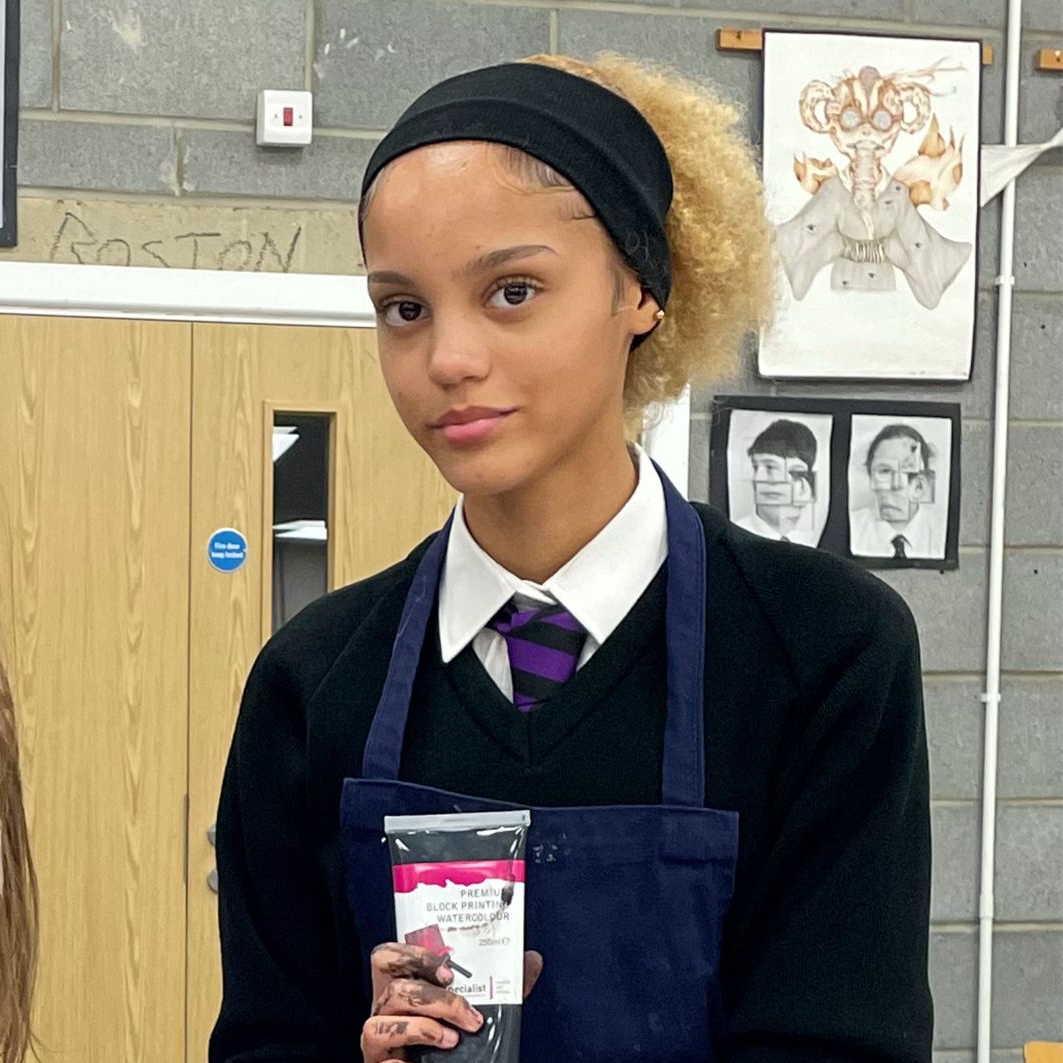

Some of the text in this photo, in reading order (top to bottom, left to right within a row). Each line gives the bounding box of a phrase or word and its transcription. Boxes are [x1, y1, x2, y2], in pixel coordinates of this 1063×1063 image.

[460, 887, 500, 898] PREMIU
[426, 902, 458, 912] BLOCK
[437, 911, 510, 923] WATERCOLOUR
[448, 984, 486, 993] pecialist
